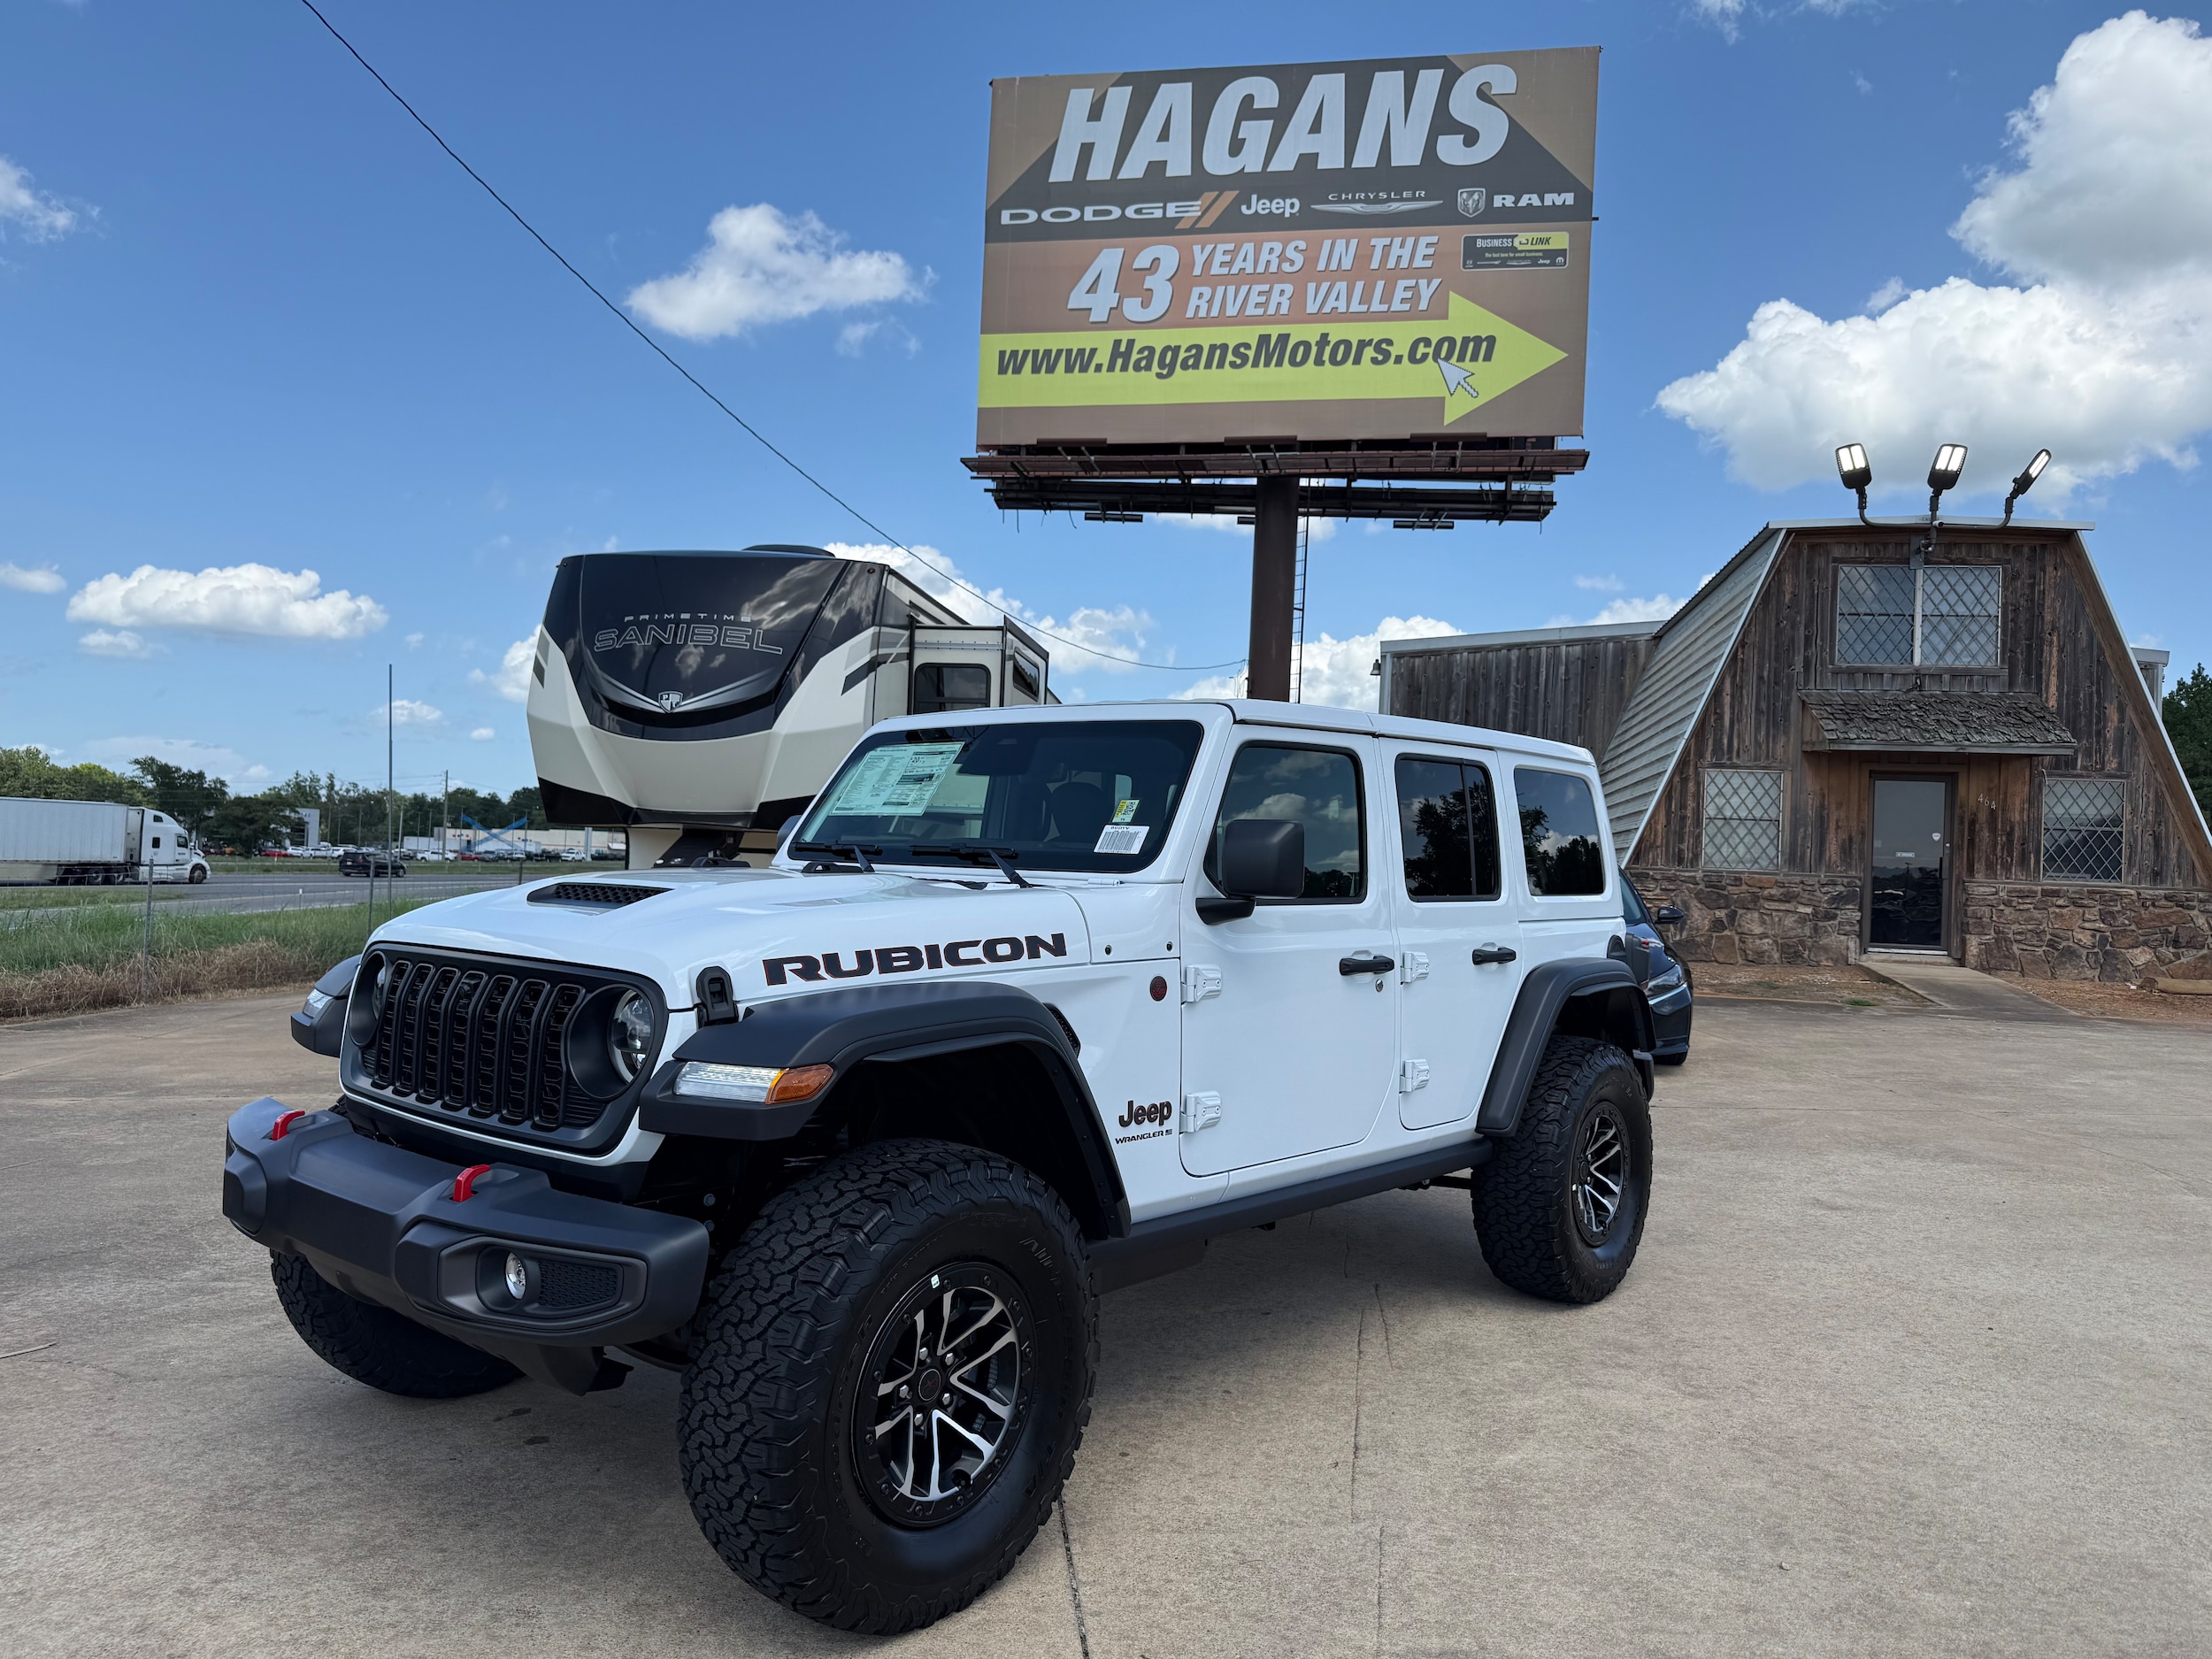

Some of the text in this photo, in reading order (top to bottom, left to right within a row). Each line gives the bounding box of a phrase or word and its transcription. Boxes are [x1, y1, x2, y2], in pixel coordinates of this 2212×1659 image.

[1048, 64, 1517, 182] HAGANS
[1240, 194, 1300, 218] Jeep
[1328, 190, 1426, 201] CHRYSLER
[1493, 192, 1575, 208] RAM
[1000, 200, 1202, 226] DODGE
[1192, 235, 1439, 277] YEARS IN THE
[1476, 236, 1552, 248] BUSINESS LINK
[1067, 244, 1181, 324] 43
[1185, 277, 1443, 319] RIVER VALLEY
[996, 332, 1497, 380] www.HagansMotors.com
[595, 624, 783, 655] SANIBEL
[1978, 793, 1996, 810] 464
[762, 932, 1067, 986] RUBICON
[1118, 1100, 1172, 1128] Jeep
[1115, 1130, 1164, 1145] WRANGLER
